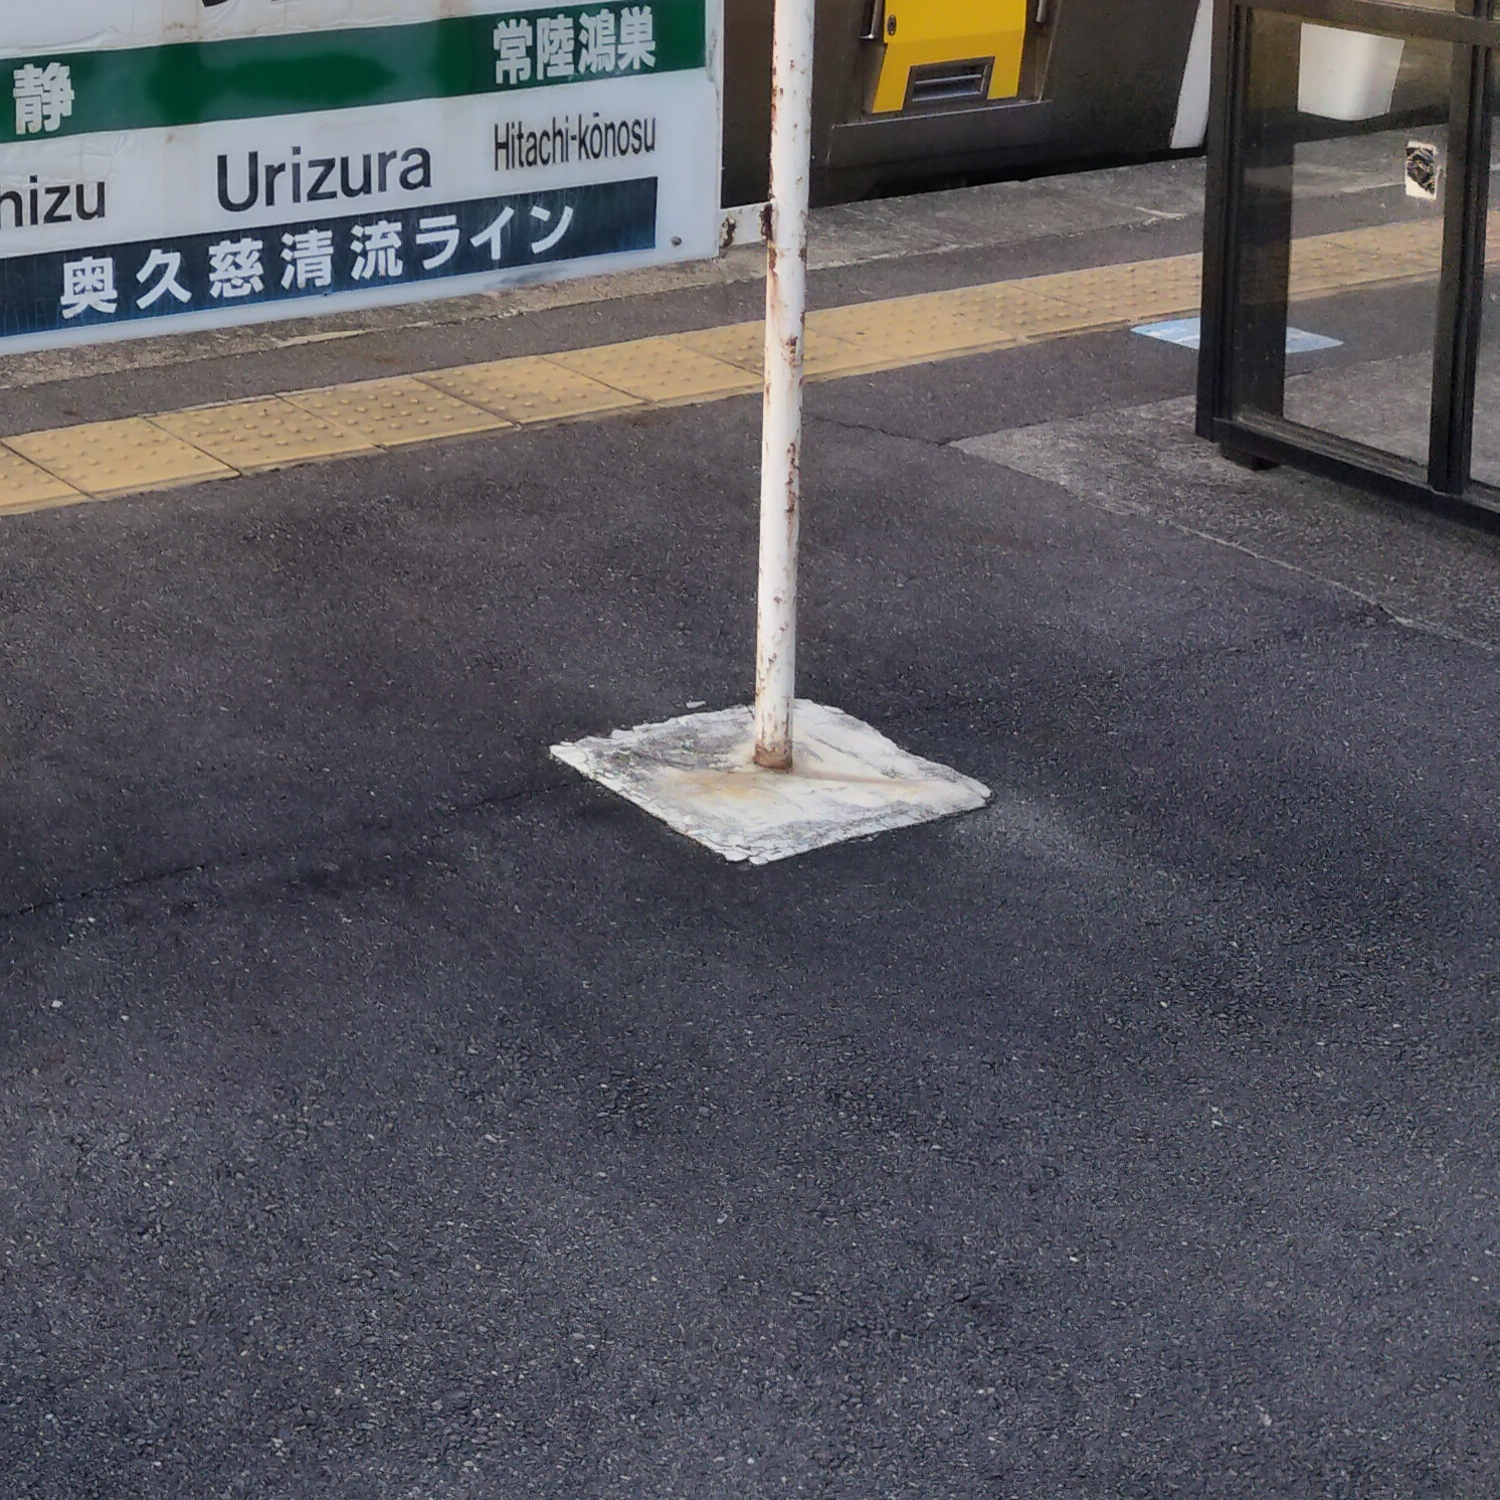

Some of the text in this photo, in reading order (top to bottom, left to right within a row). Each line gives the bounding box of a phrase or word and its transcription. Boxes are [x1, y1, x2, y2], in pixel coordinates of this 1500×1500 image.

[492, 6, 658, 86] 常陸鴻巣
[13, 62, 77, 134] 静
[494, 113, 657, 172] Hitachi-kōnosu
[217, 146, 432, 213] Urizura
[59, 205, 575, 320] 奥久慈清流ライン
